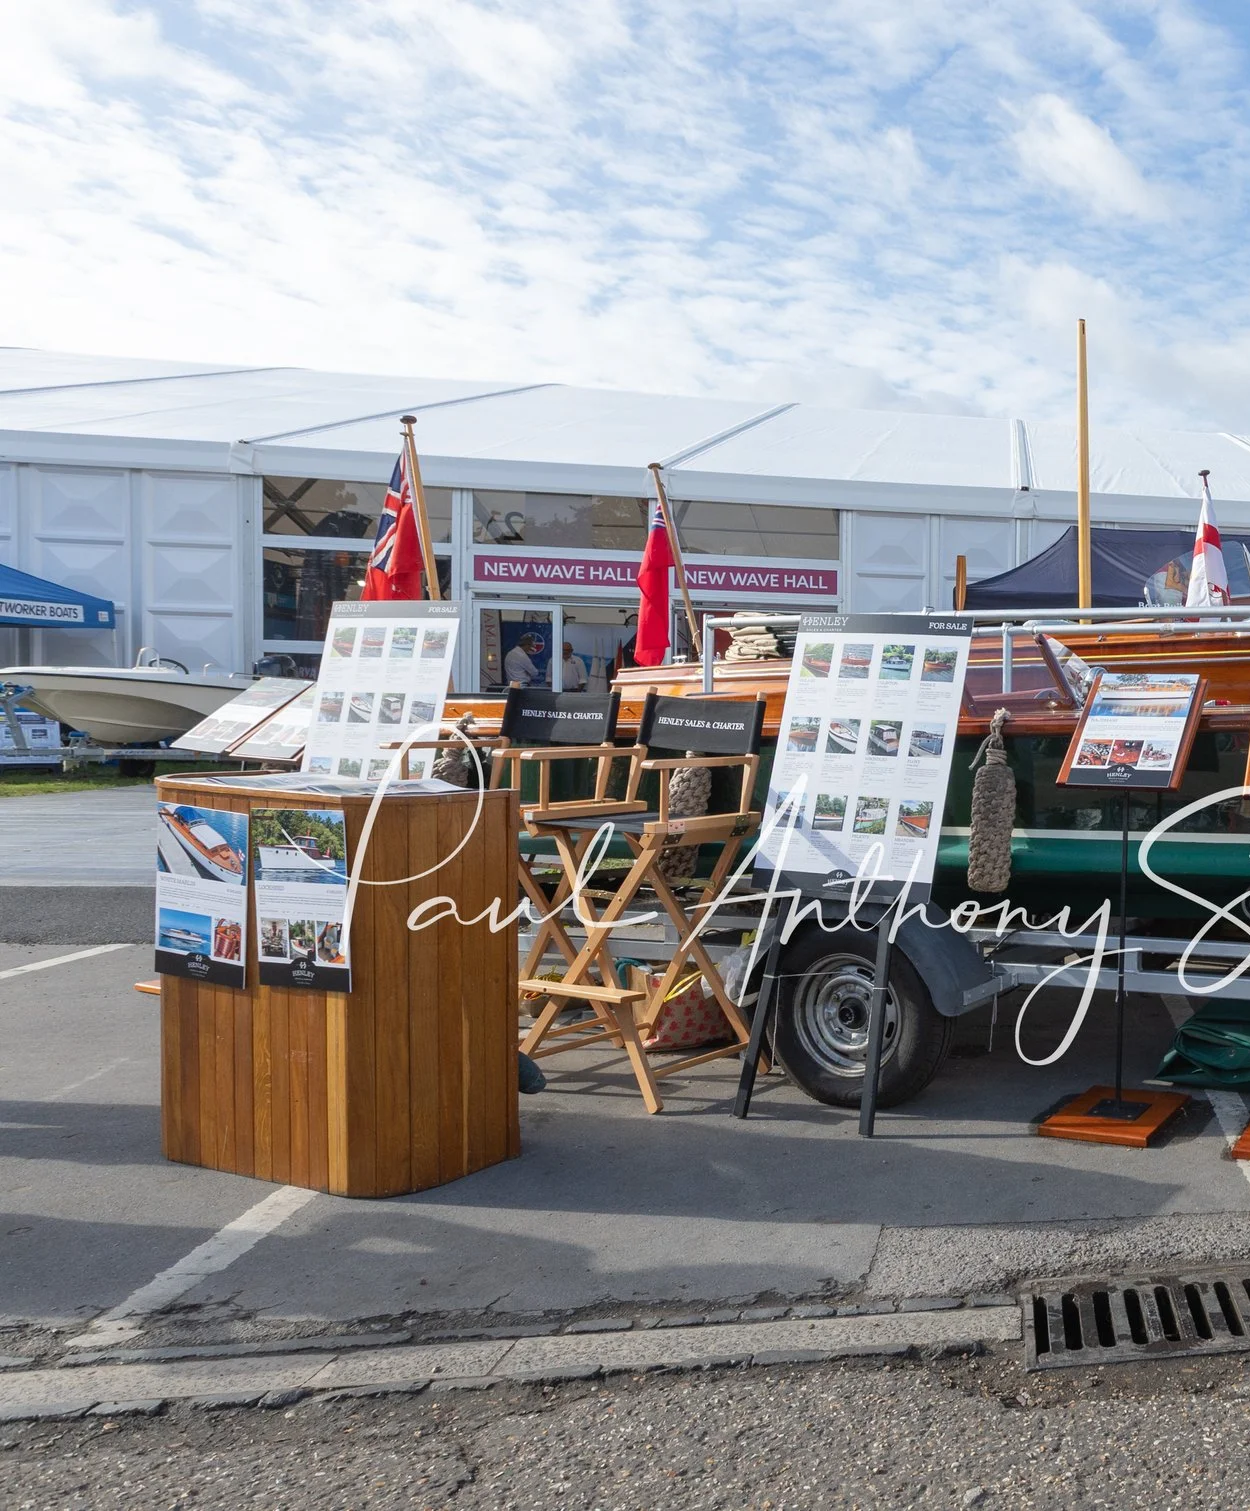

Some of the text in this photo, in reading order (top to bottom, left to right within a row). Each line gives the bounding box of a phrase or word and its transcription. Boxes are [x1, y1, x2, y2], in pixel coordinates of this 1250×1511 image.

[484, 561, 637, 582] NEW WAVE HALL
[684, 570, 829, 590] NEW WAVE HALL
[50, 607, 79, 619] BOATS
[334, 603, 370, 613] HENLEY
[802, 616, 849, 626] HENLEY
[928, 621, 968, 631] FOR SALE
[521, 709, 548, 718] HENLEY
[547, 711, 567, 719] SALES
[573, 712, 604, 720] CHARTER
[658, 716, 745, 731] HENLEY SALES & CHARTER
[187, 961, 211, 972] HENLEY
[291, 969, 315, 979] HENLEY
